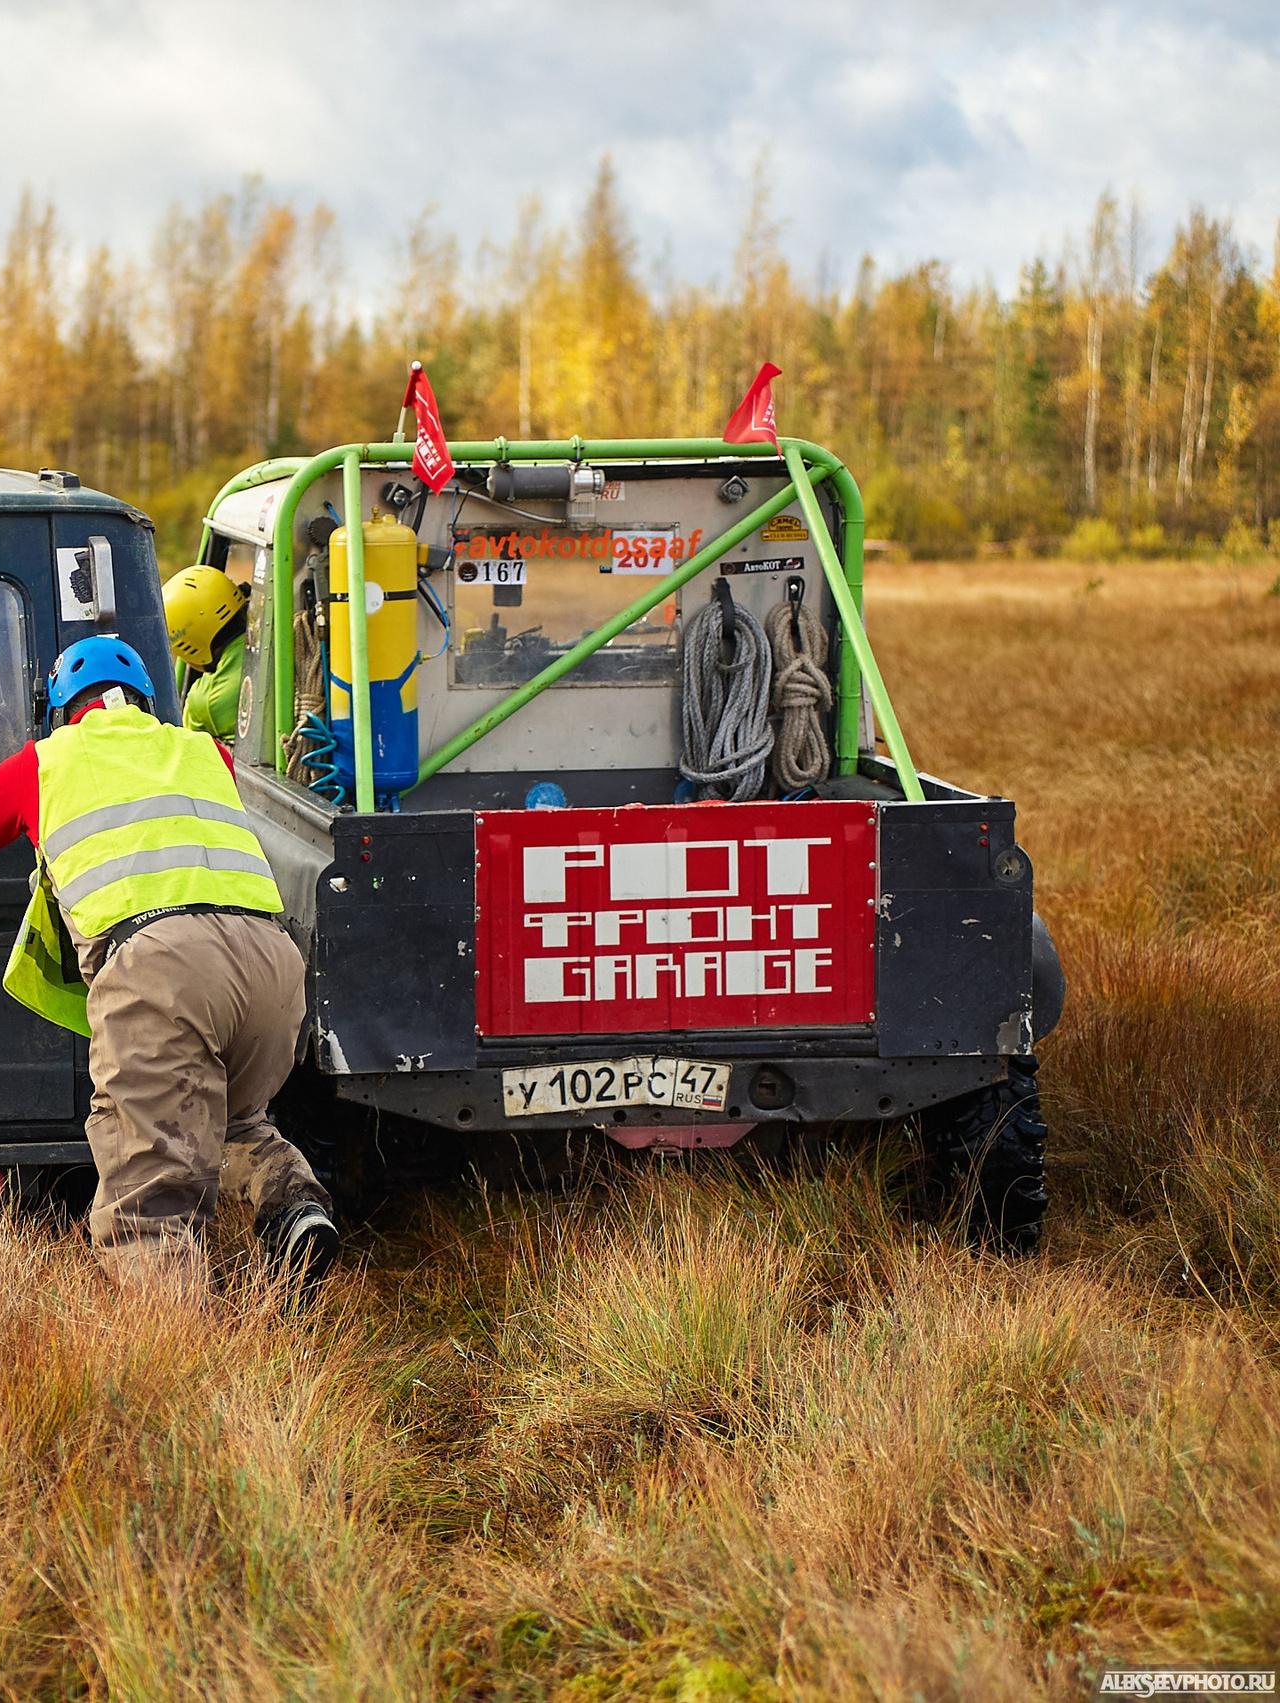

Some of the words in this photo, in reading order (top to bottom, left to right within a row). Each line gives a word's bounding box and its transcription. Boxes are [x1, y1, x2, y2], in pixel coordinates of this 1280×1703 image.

[483, 562, 524, 582] 167
[524, 947, 832, 1003] GARAGE
[681, 1065, 717, 1094] 47
[676, 1092, 702, 1104] RUS
